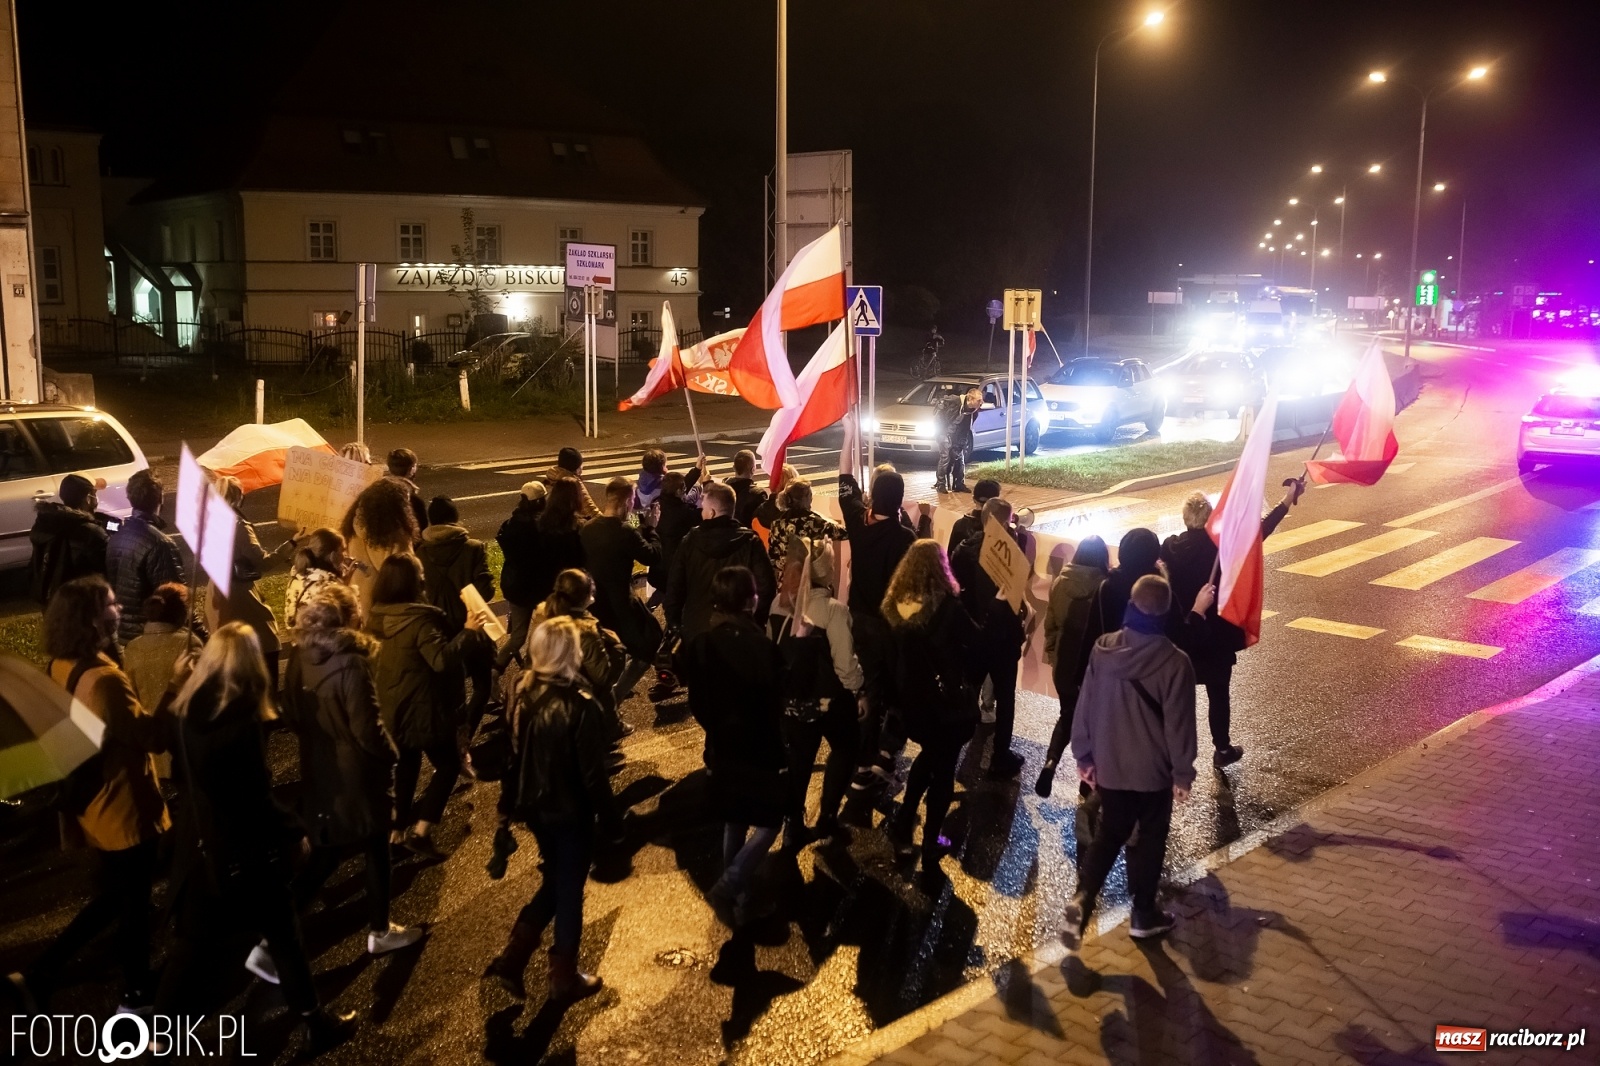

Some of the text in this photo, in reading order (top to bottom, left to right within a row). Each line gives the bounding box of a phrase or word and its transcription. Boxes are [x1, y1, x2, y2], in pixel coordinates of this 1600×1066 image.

[396, 269, 565, 289] ZAJAZD BISKU
[670, 272, 688, 287] 45
[291, 450, 313, 467] NA
[288, 467, 312, 484] NA
